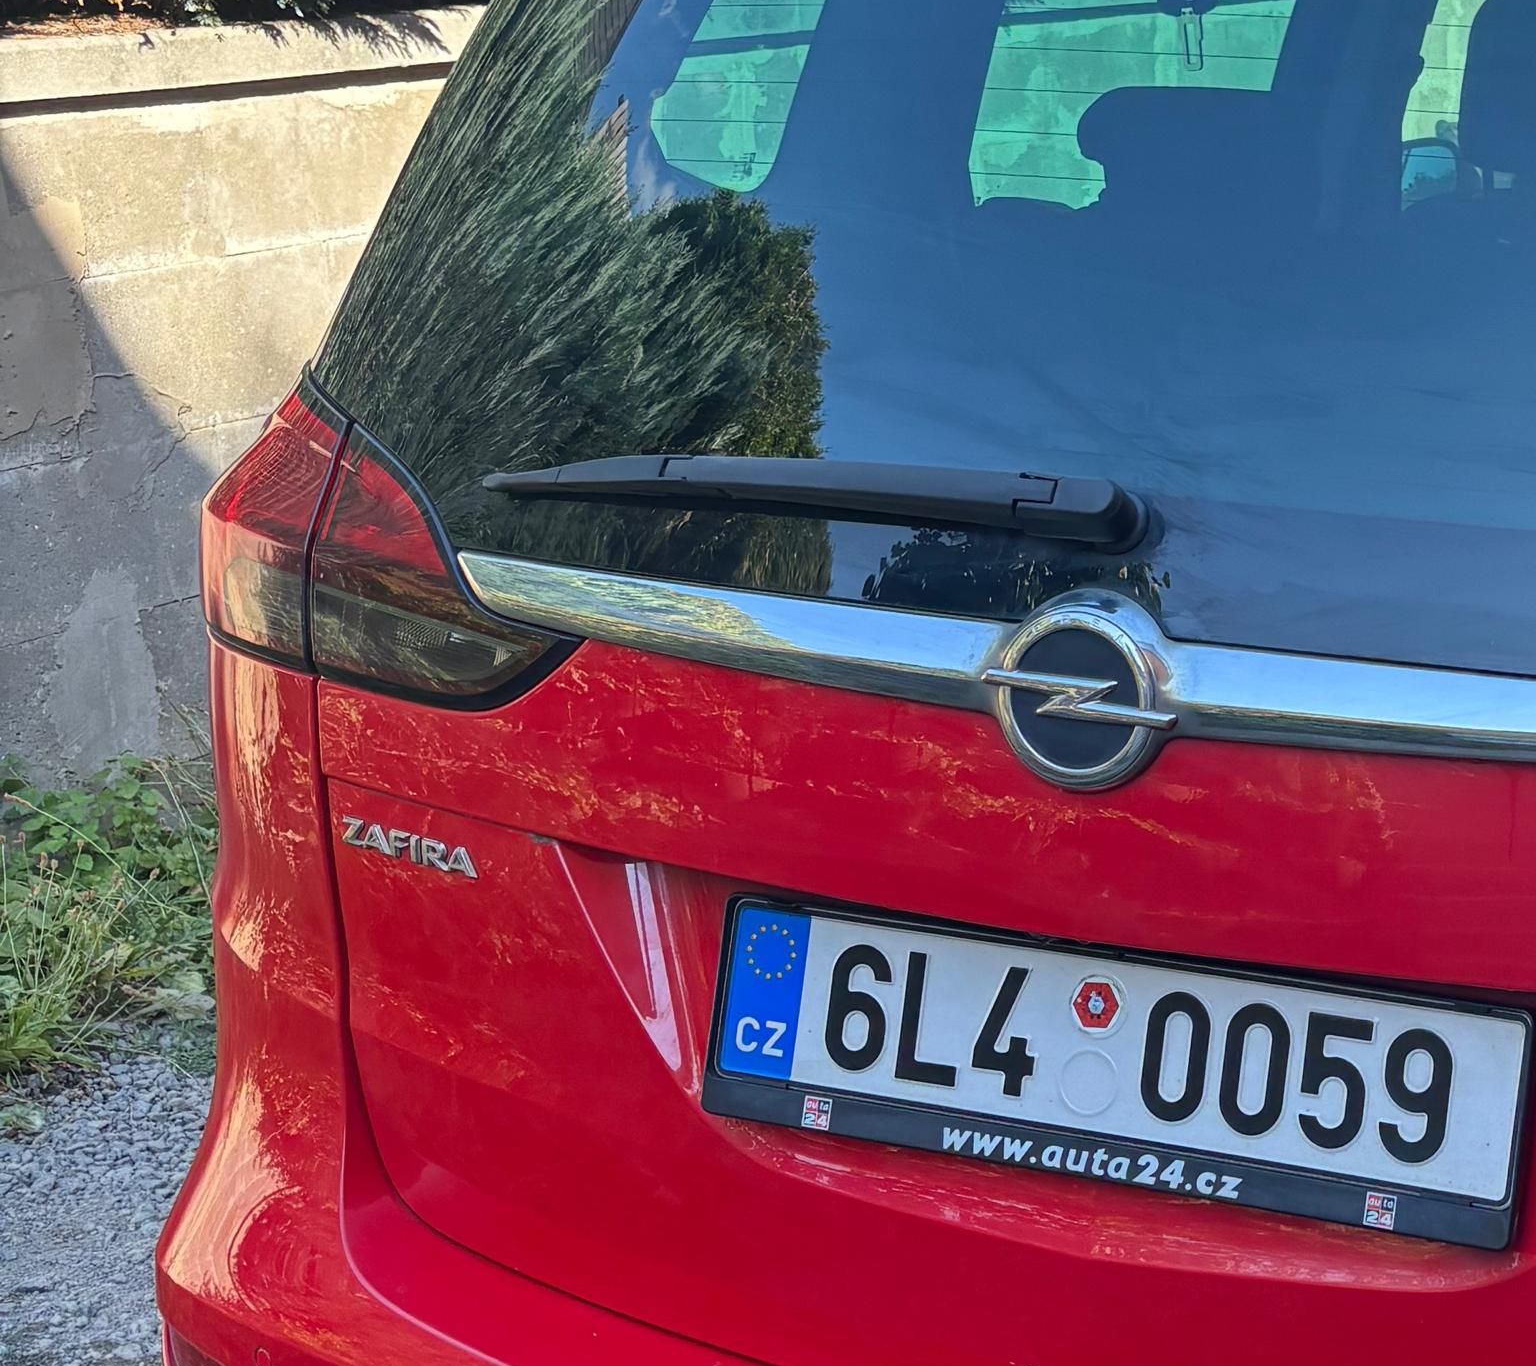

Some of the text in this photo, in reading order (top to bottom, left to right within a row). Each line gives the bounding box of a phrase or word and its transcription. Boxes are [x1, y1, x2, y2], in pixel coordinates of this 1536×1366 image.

[342, 815, 479, 879] ZAFIRA
[735, 1016, 788, 1057] CZ
[824, 943, 1455, 1164] 6L4 0059
[942, 1127, 1243, 1199] www.auta24.cz
[1366, 1211, 1392, 1225] 24
